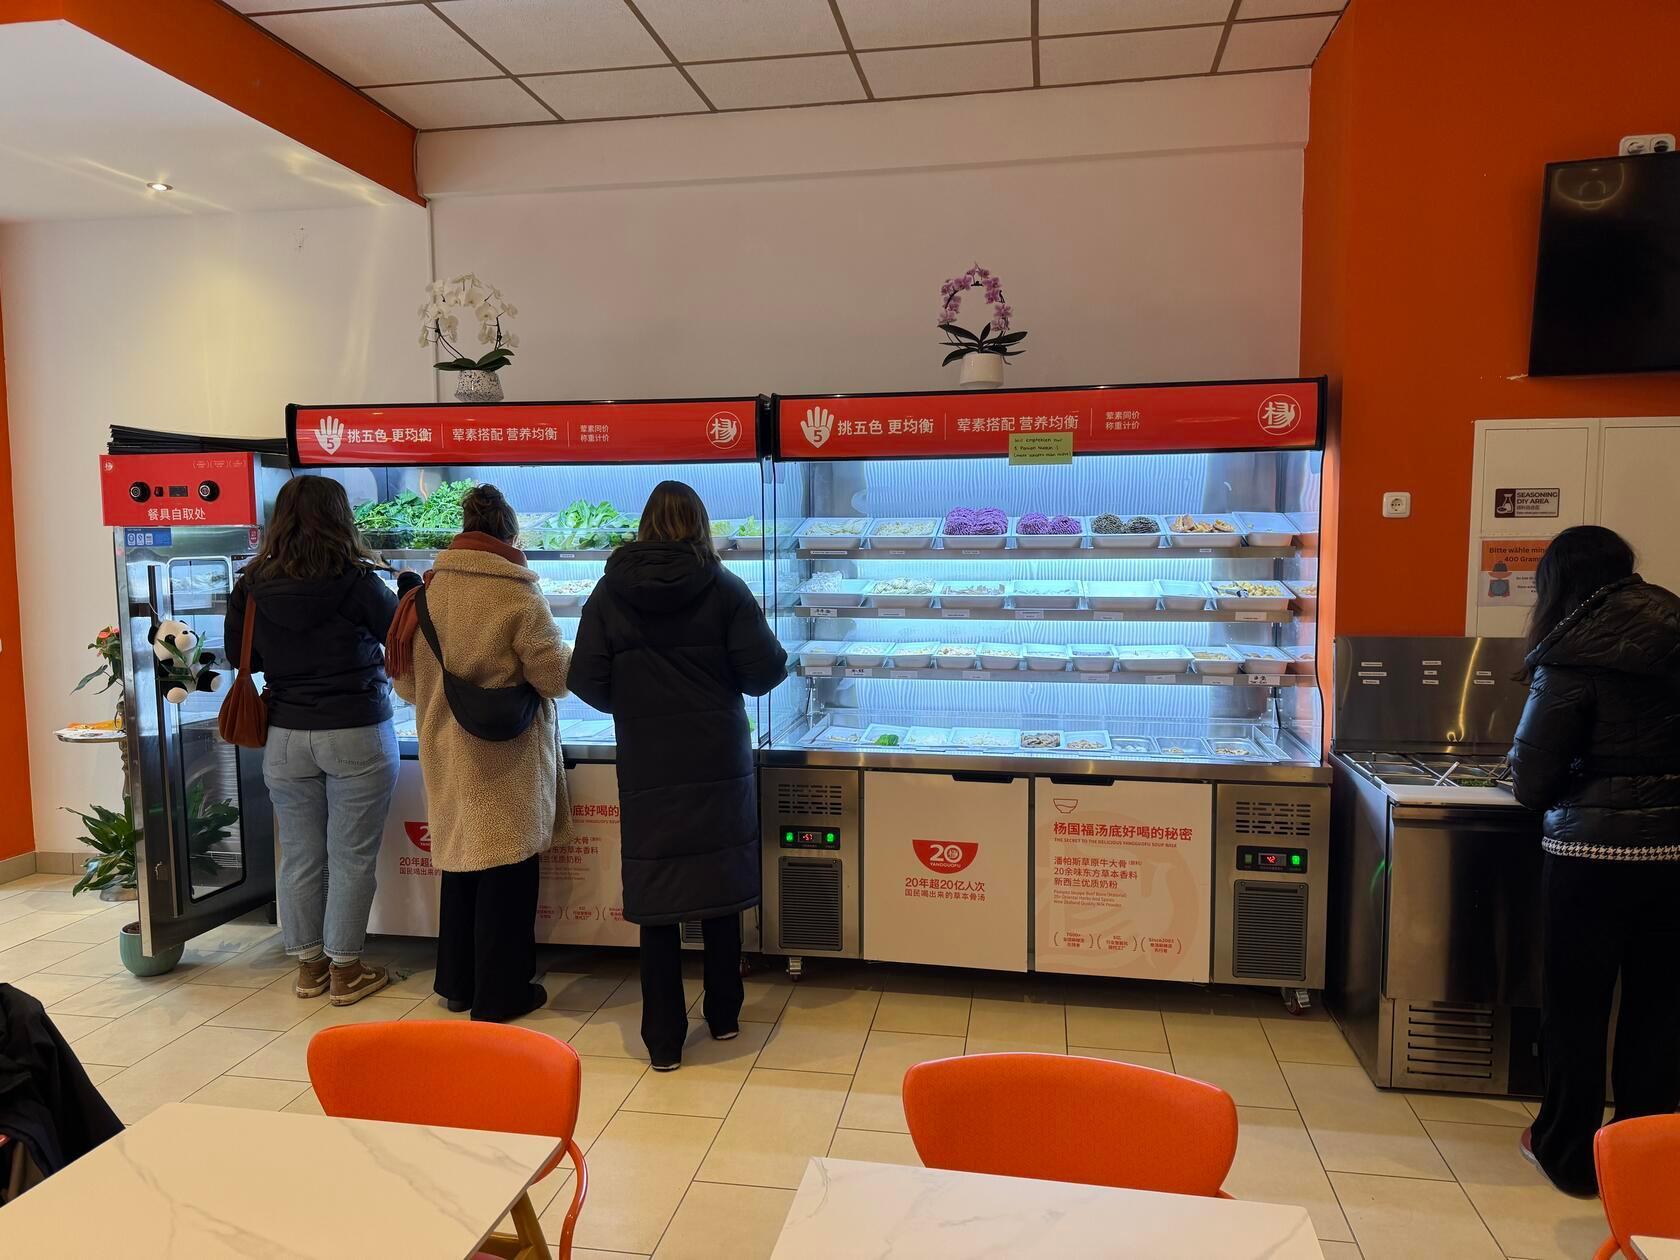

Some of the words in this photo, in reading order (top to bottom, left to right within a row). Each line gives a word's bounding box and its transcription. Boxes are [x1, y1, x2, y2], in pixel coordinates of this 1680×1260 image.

[838, 420, 883, 436] 挑五色
[888, 418, 934, 434] 更均衡
[957, 417, 1016, 432] 荤素搭配
[1020, 415, 1078, 431] 营养均衡
[1105, 421, 1140, 430] 称重计价
[348, 428, 387, 443] 挑五色
[392, 428, 432, 442] 更均衡
[452, 428, 503, 442] 荤素搭配
[506, 427, 558, 441] 营养均衡
[580, 434, 609, 442] 称重计价
[814, 430, 823, 442] 5
[326, 438, 335, 450] 5
[148, 508, 206, 521] 餐具自取处
[1053, 821, 1193, 841] 杨国福汤底好喝的秘密
[930, 844, 962, 864] 20
[1054, 867, 1138, 880] 20余味东方草本香料
[905, 878, 985, 892] 20年超20亿人次
[1054, 878, 1118, 890] 新西兰优质奶粉
[904, 888, 986, 902] 国民喝出来的草本骨汤
